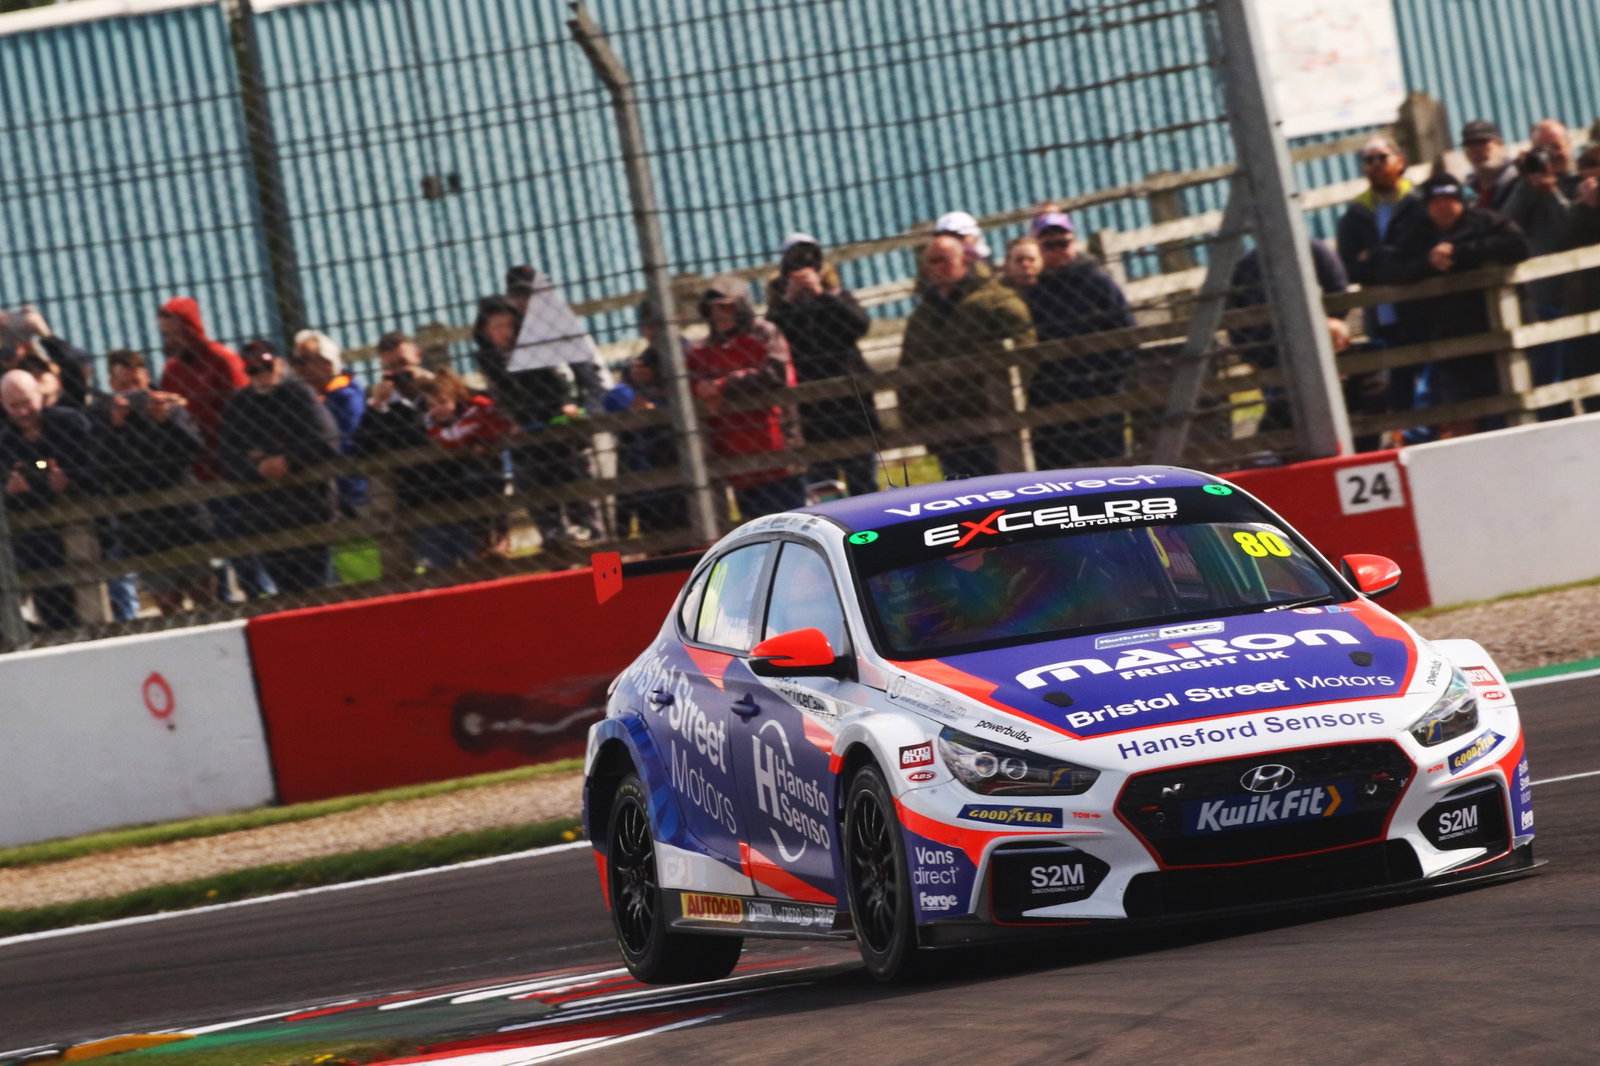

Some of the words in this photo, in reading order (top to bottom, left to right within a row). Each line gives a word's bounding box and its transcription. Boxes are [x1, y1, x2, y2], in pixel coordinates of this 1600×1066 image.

[1347, 472, 1391, 505] 24
[924, 497, 1178, 549] EXCELR8
[1059, 512, 1178, 530] MOTORSPORT
[1233, 531, 1292, 558] 80
[1119, 655, 1238, 680] FREIGHT
[1243, 651, 1290, 663] UK
[1065, 690, 1182, 729] Bristol
[1186, 677, 1291, 703] Street
[1296, 672, 1395, 691] Motors
[669, 672, 727, 774] Street
[975, 719, 1032, 744] powerbulbs
[1117, 719, 1256, 761] Hansford
[1264, 707, 1386, 734] Sensors
[903, 746, 931, 758] AUTO
[670, 739, 737, 835] Motors
[968, 807, 1054, 823] GOODYEAR
[1438, 805, 1478, 834] S2M
[915, 847, 954, 865] Vans
[913, 866, 957, 885] direct
[1030, 863, 1085, 887] S2M
[687, 894, 741, 921] AUTOCAR
